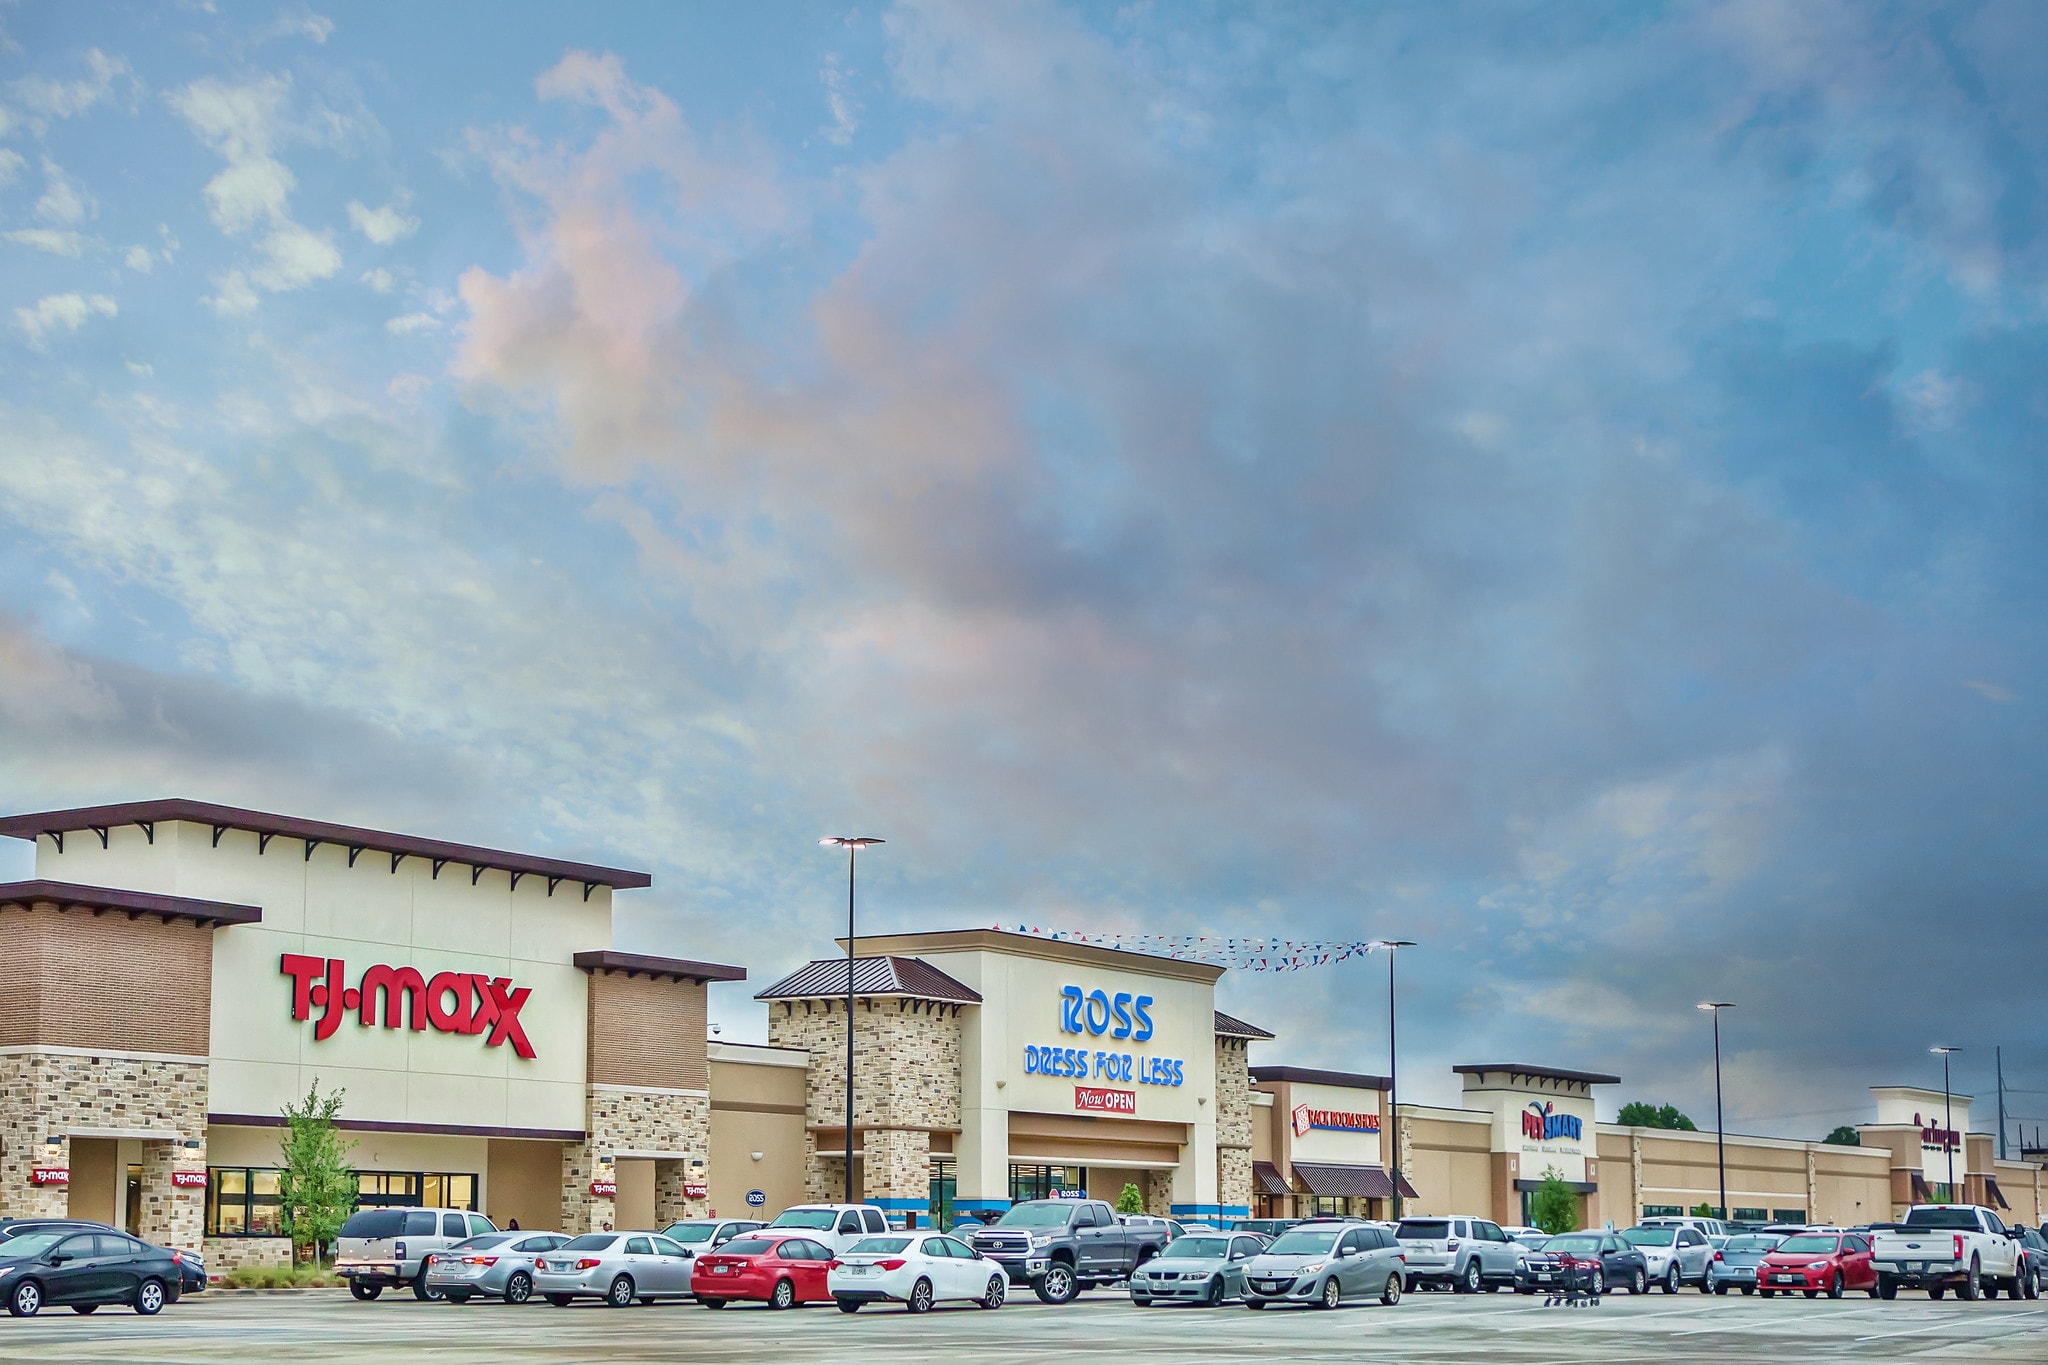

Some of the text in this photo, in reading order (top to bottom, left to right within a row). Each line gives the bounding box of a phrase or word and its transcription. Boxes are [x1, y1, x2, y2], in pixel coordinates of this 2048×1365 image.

[1060, 985, 1154, 1041] ROSS
[1024, 1045, 1184, 1086] DRESS FOR LESS
[1077, 1091, 1134, 1110] Now OPEN
[1308, 1110, 1329, 1126] RACK
[1330, 1111, 1355, 1128] ROOM
[1355, 1113, 1379, 1130] SHOES
[749, 1194, 764, 1202] ROSS
[1061, 1190, 1080, 1198] ROSS
